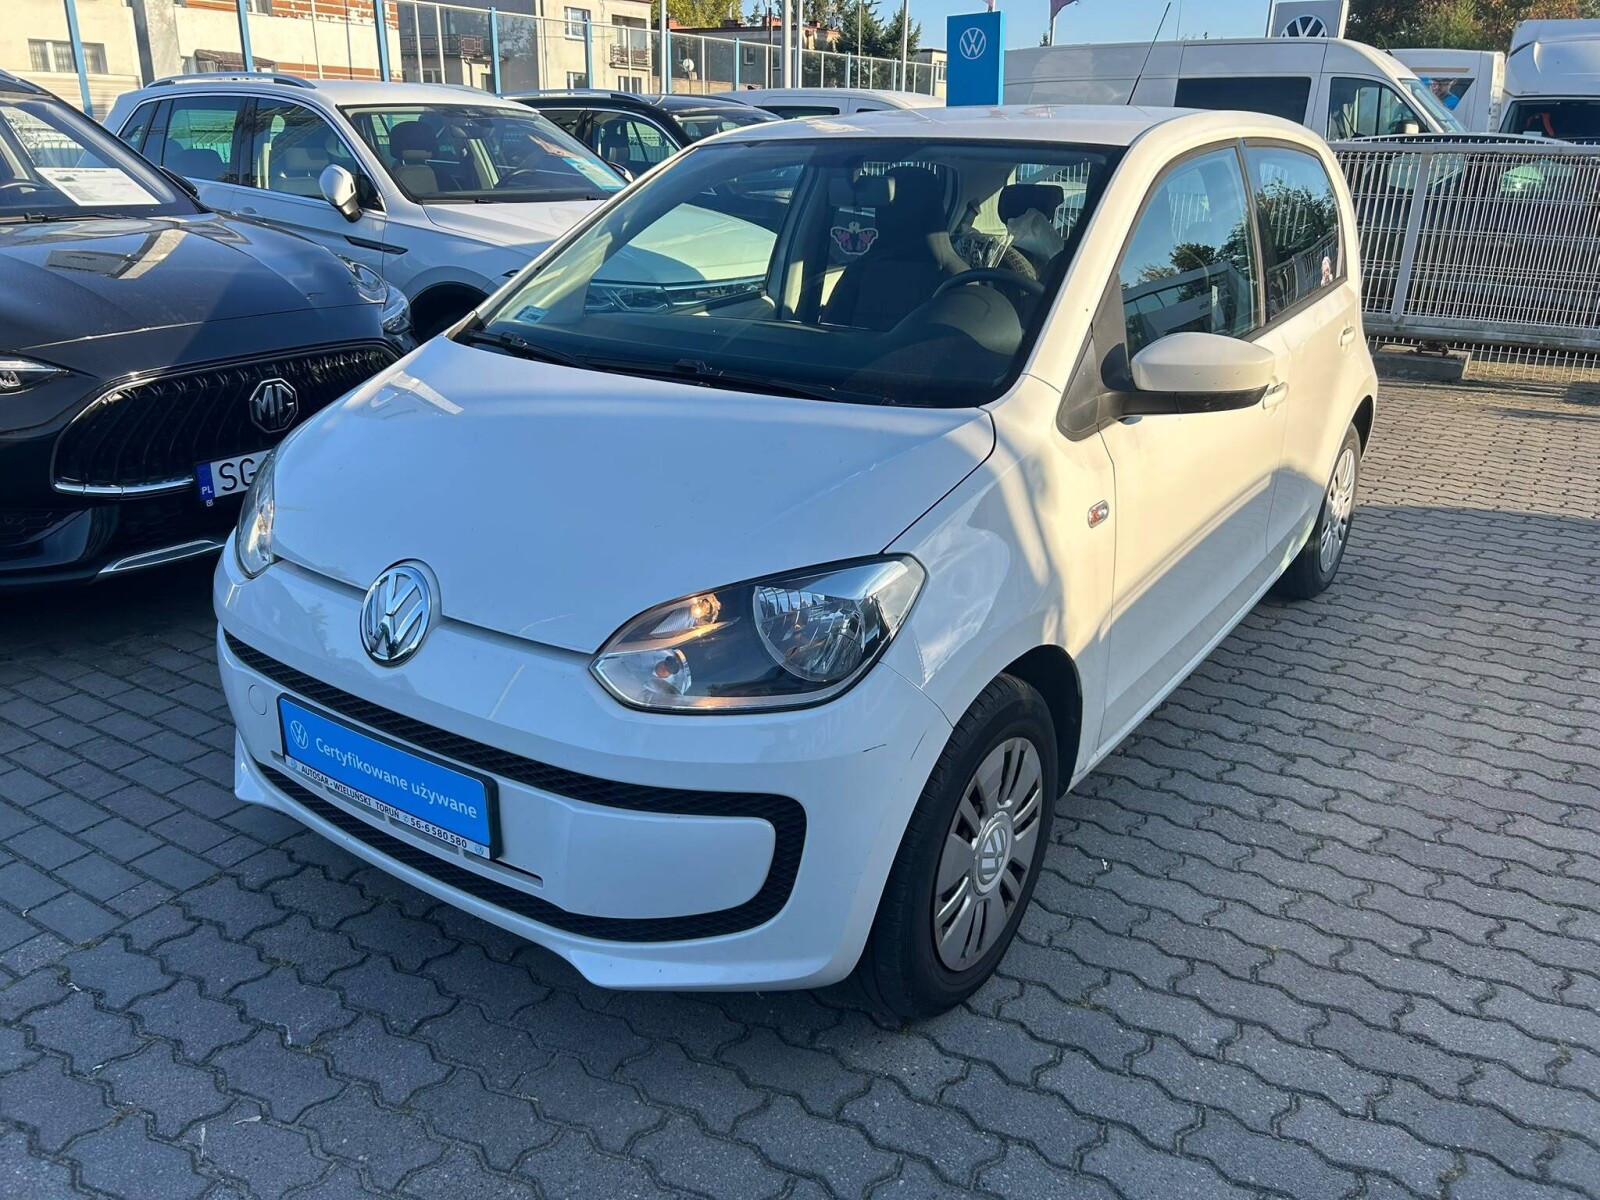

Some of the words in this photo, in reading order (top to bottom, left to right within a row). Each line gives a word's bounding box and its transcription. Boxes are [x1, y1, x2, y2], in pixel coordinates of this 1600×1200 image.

[959, 27, 987, 60] VW
[253, 381, 296, 431] MG
[201, 485, 213, 495] PL
[360, 565, 431, 666] VW
[290, 719, 309, 750] VW
[316, 737, 408, 791] Certyfikowane
[411, 782, 478, 819] używane
[431, 826, 449, 841] 580
[450, 836, 467, 849] 580
